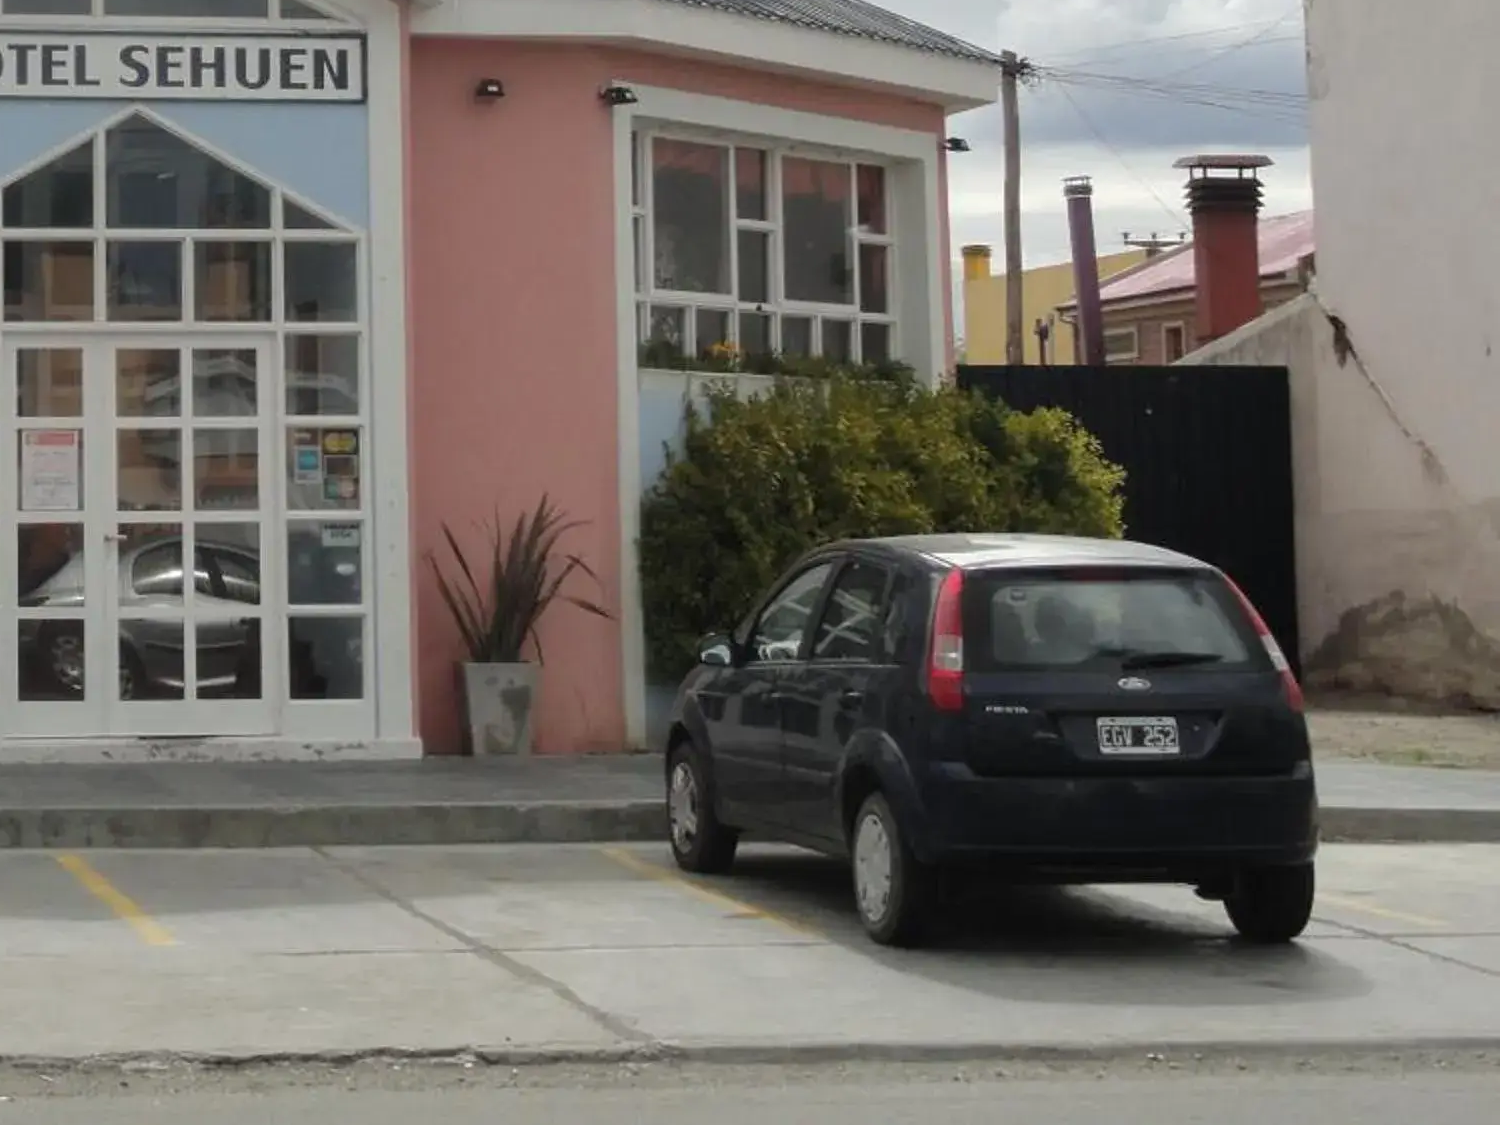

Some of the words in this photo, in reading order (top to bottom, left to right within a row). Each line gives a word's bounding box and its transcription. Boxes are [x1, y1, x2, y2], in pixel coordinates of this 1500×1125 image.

[119, 45, 349, 90] SEHUEN
[1102, 726, 1133, 746] EGV
[1144, 726, 1175, 747] 252
